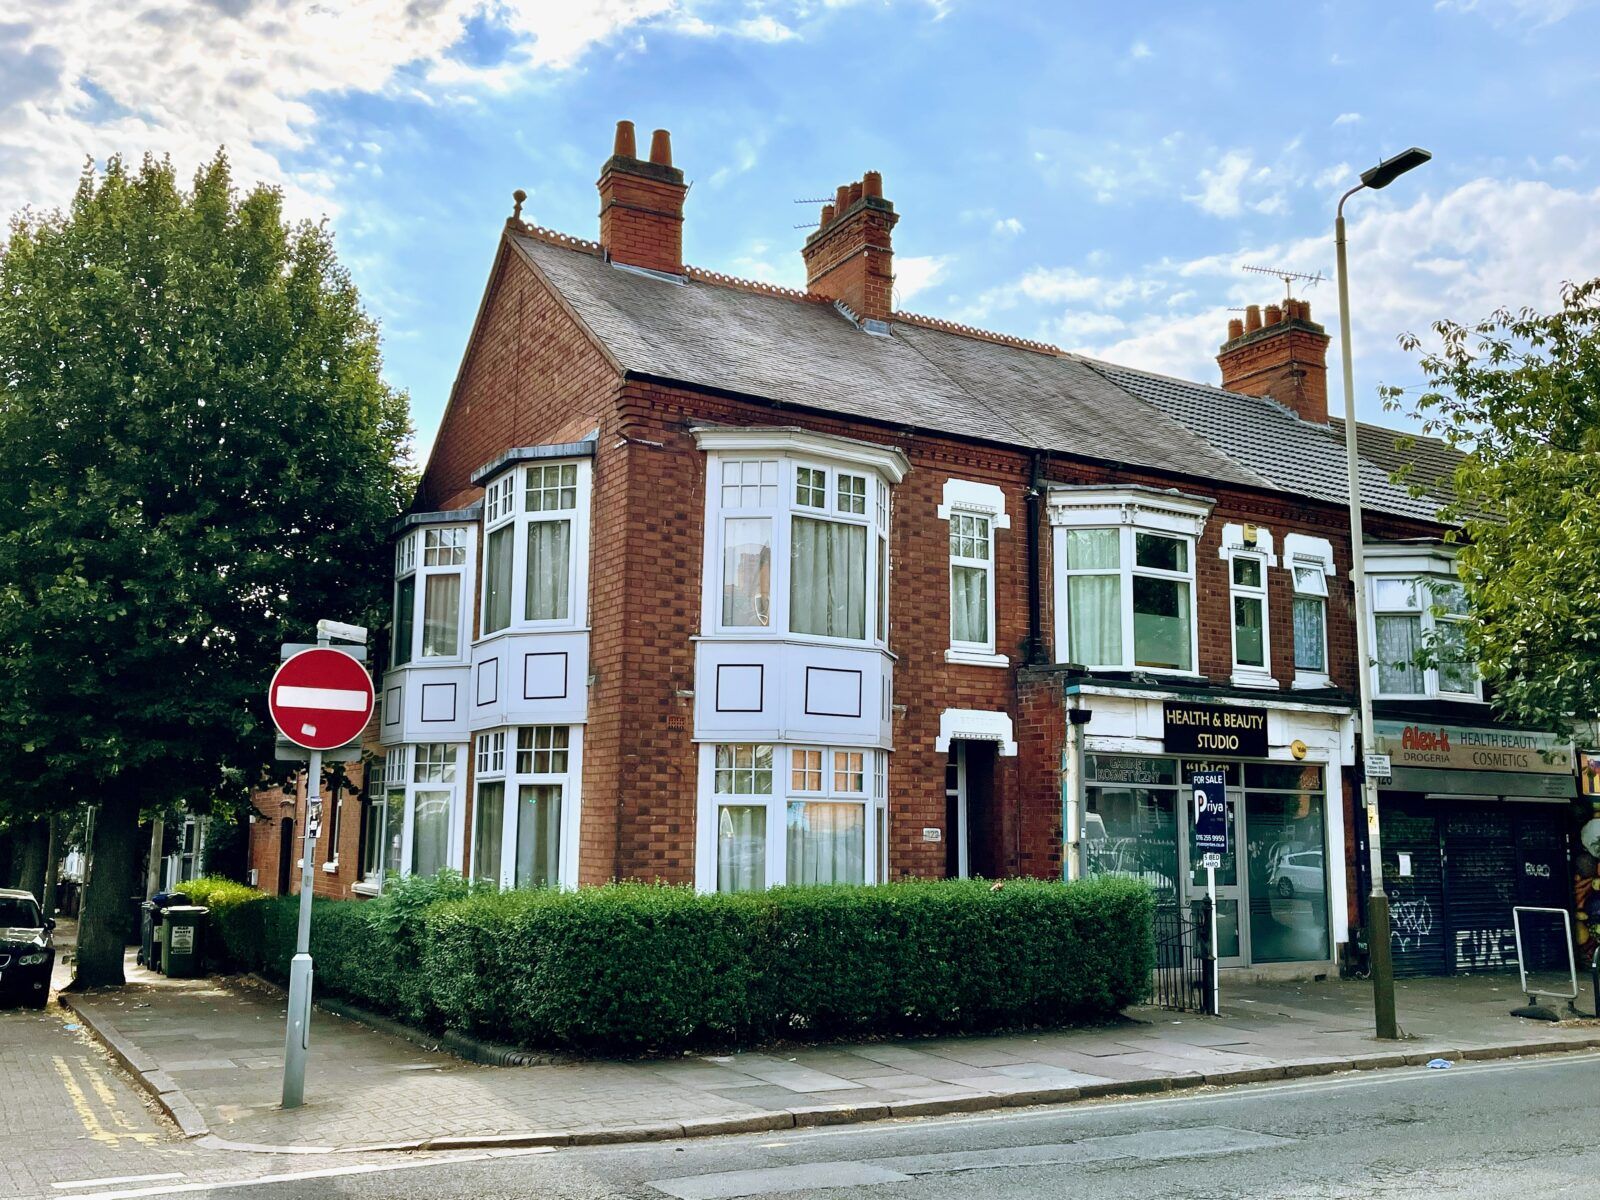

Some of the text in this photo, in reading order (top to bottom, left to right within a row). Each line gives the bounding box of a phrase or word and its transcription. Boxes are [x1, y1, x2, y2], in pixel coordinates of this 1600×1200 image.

[1166, 709, 1263, 729] HEALTH & BEAUTY
[1197, 733, 1239, 750] STUDIO
[1460, 732, 1538, 749] HEALTH BEAUTY
[1404, 752, 1450, 763] DROGERIA
[1473, 751, 1528, 768] COSMETICS
[1193, 775, 1223, 784] FOR SALE
[1194, 789, 1224, 825] Priya
